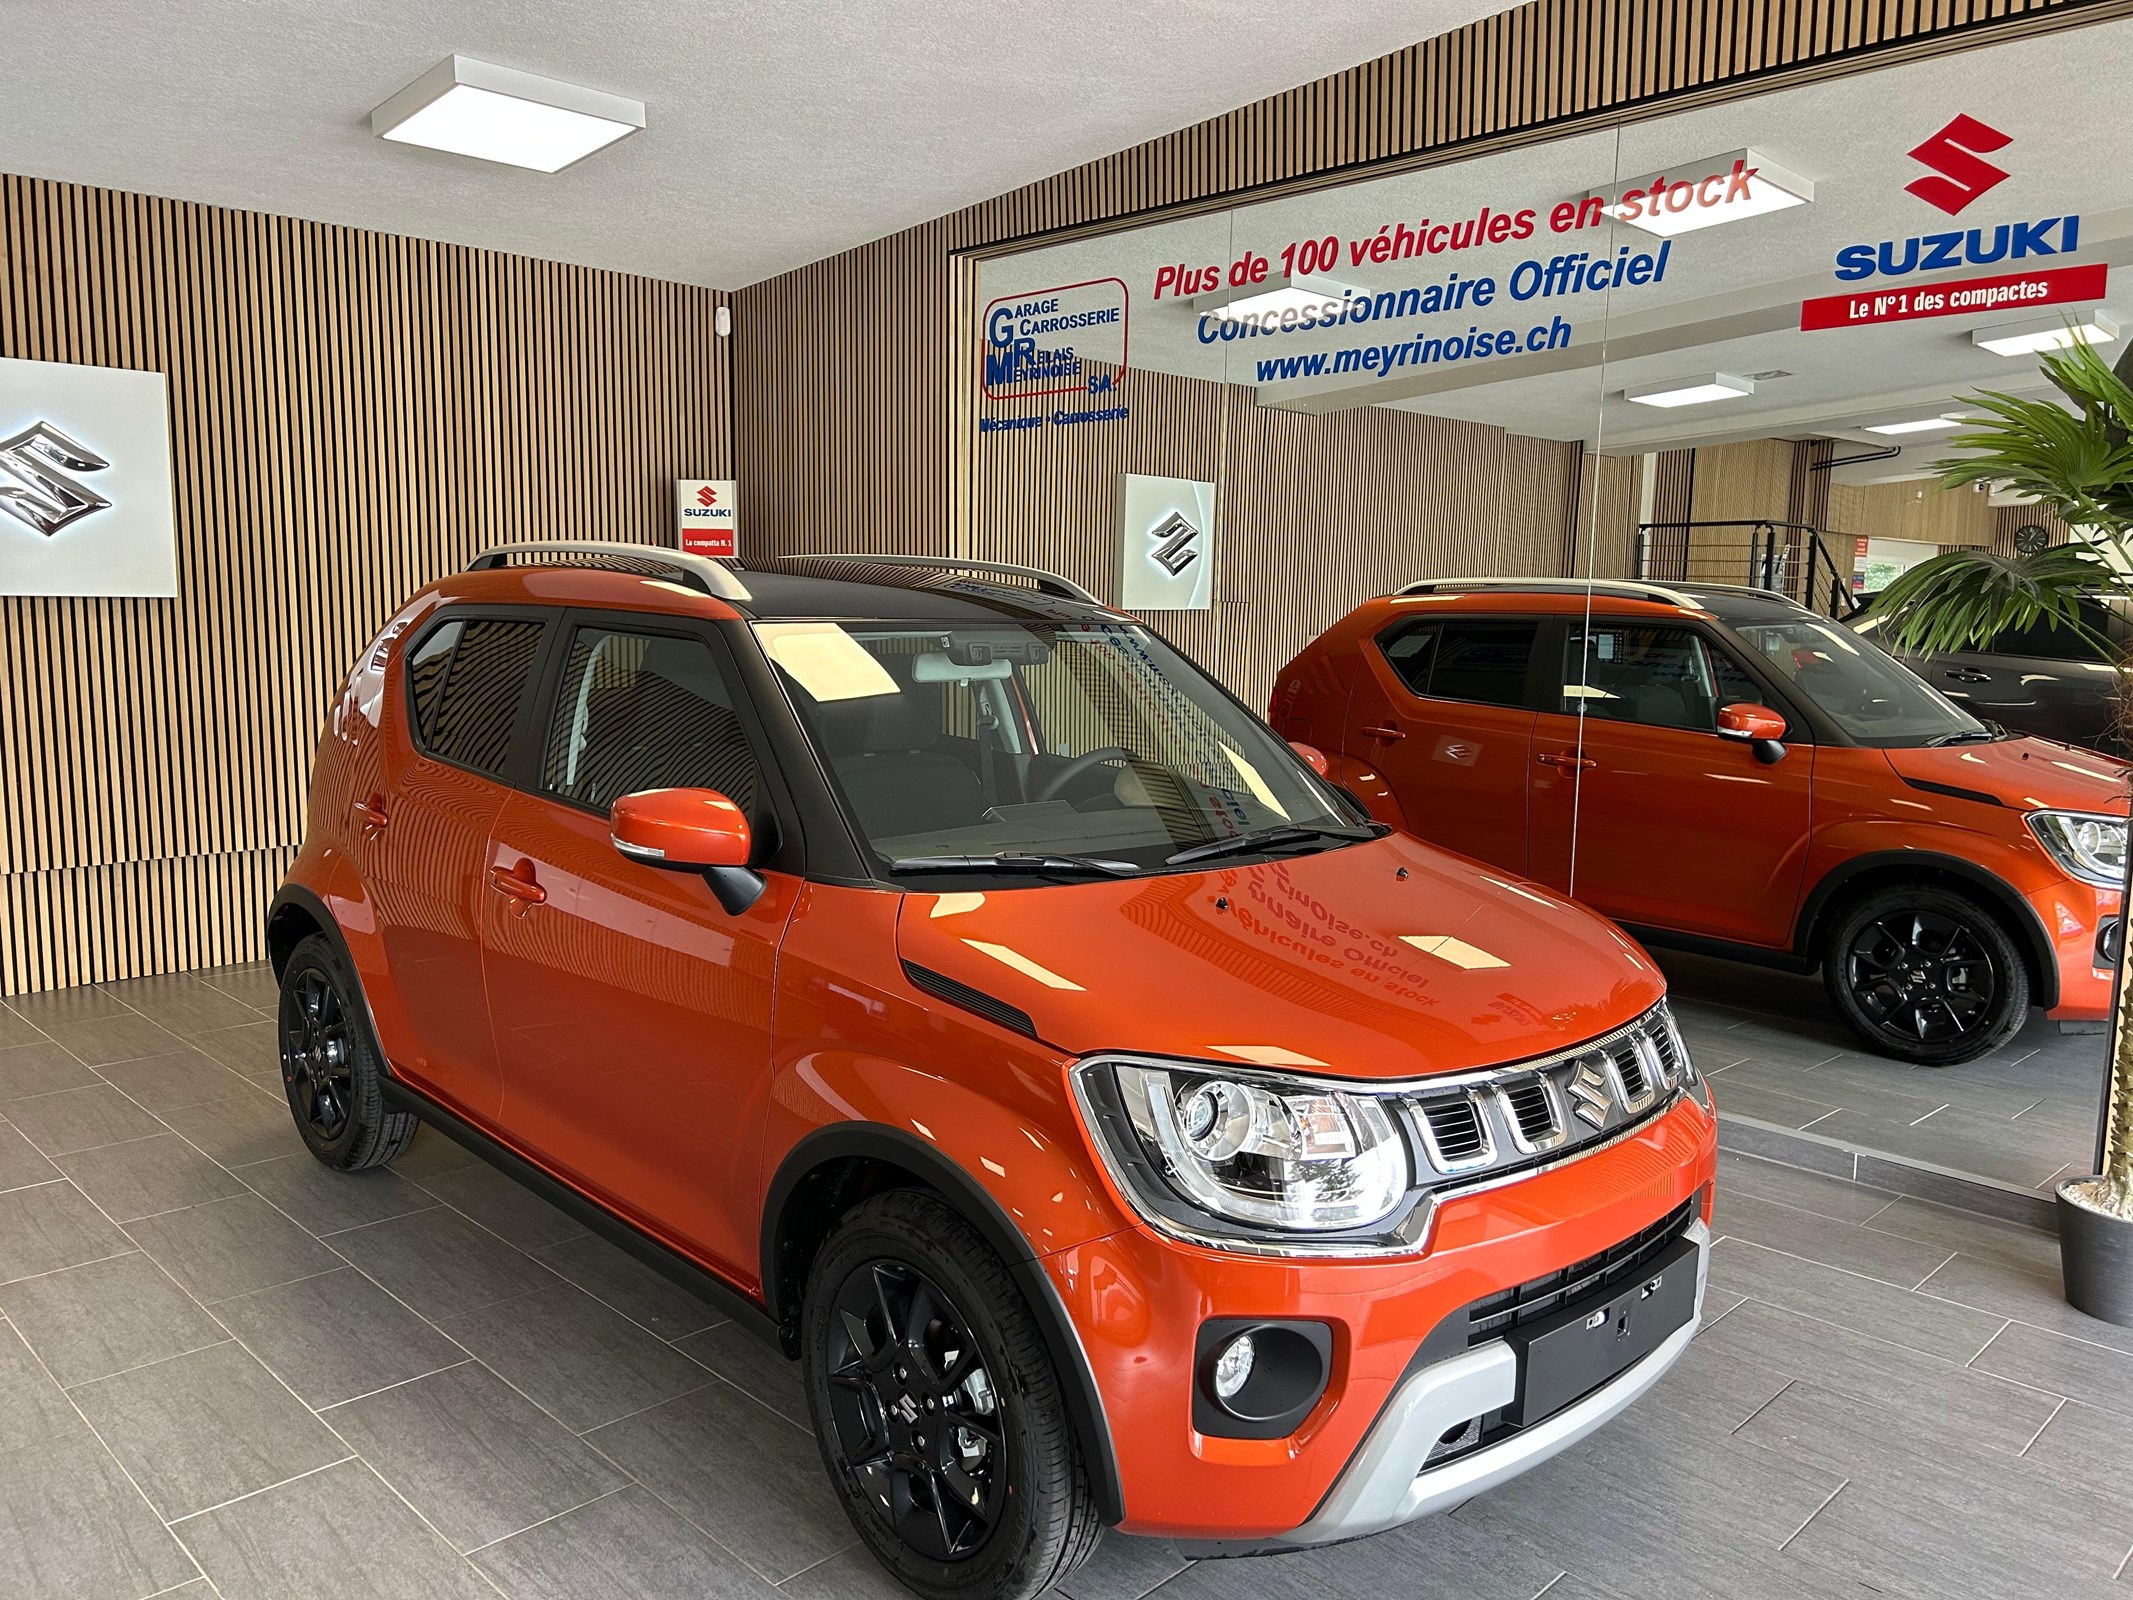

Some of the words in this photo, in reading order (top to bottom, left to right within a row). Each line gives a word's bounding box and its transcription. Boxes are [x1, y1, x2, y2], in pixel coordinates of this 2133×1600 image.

[1154, 264, 1220, 300] Plus
[1229, 251, 1268, 287] de
[1281, 235, 1340, 277] 100
[1350, 207, 1535, 267] véhicules
[1550, 197, 1605, 230] en
[1618, 158, 1760, 223] stock
[1834, 215, 2080, 281] SUZUKI
[1019, 308, 1120, 336] CARROSSERIE
[1197, 273, 1496, 344] Concessionnaire
[1508, 240, 1671, 300] Officiel
[1849, 300, 1868, 319] Le
[1914, 292, 1944, 312] des
[1950, 281, 2048, 308] compactes
[1256, 315, 1572, 382] www.meyrinoise.ch
[684, 508, 731, 517] SUZUKI
